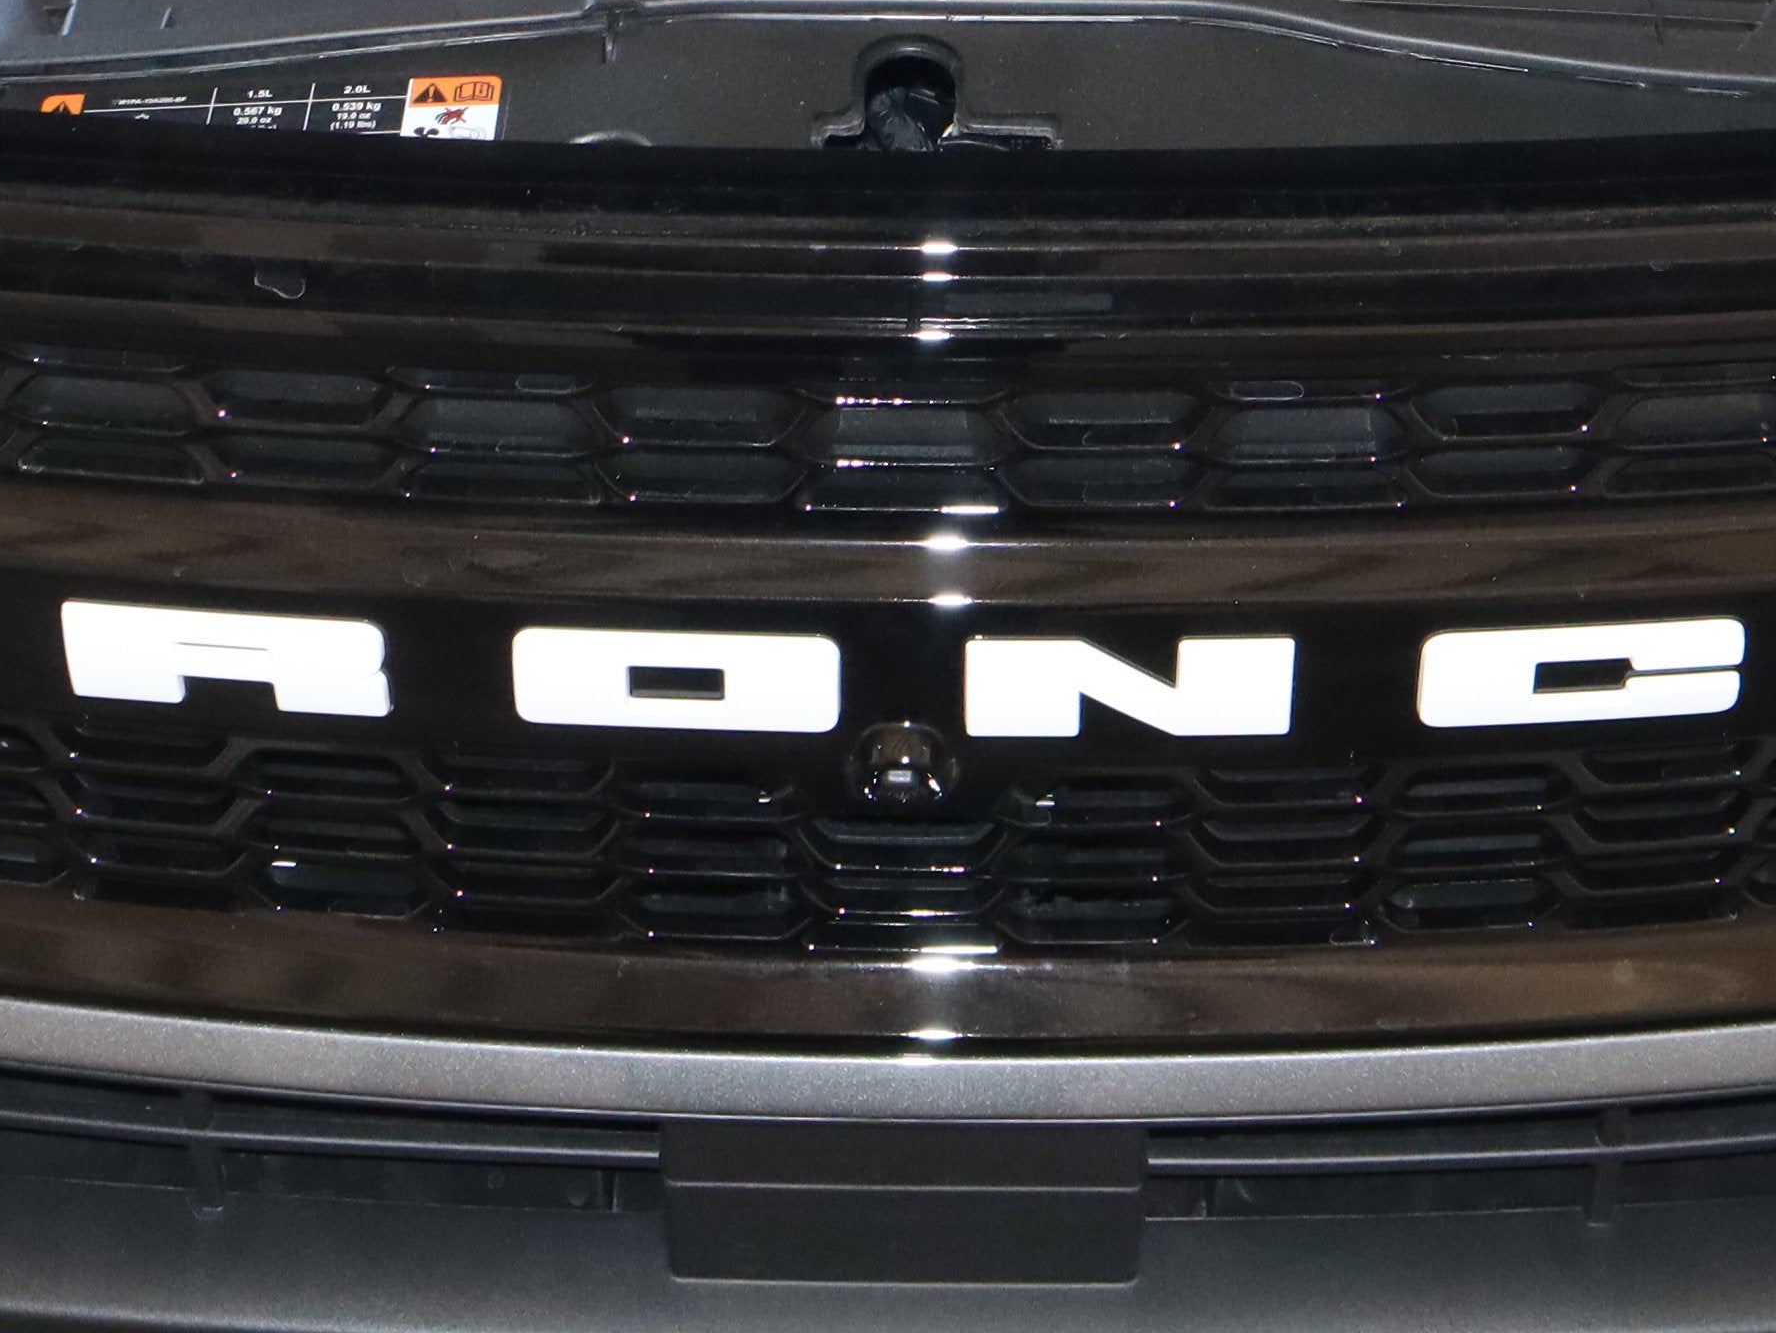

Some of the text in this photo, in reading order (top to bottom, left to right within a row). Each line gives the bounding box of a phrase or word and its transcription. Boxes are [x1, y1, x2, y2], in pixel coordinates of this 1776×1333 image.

[247, 89, 273, 99] 1.5L
[343, 85, 372, 94] 2.0L
[266, 106, 284, 117] kg
[366, 102, 382, 112] kg
